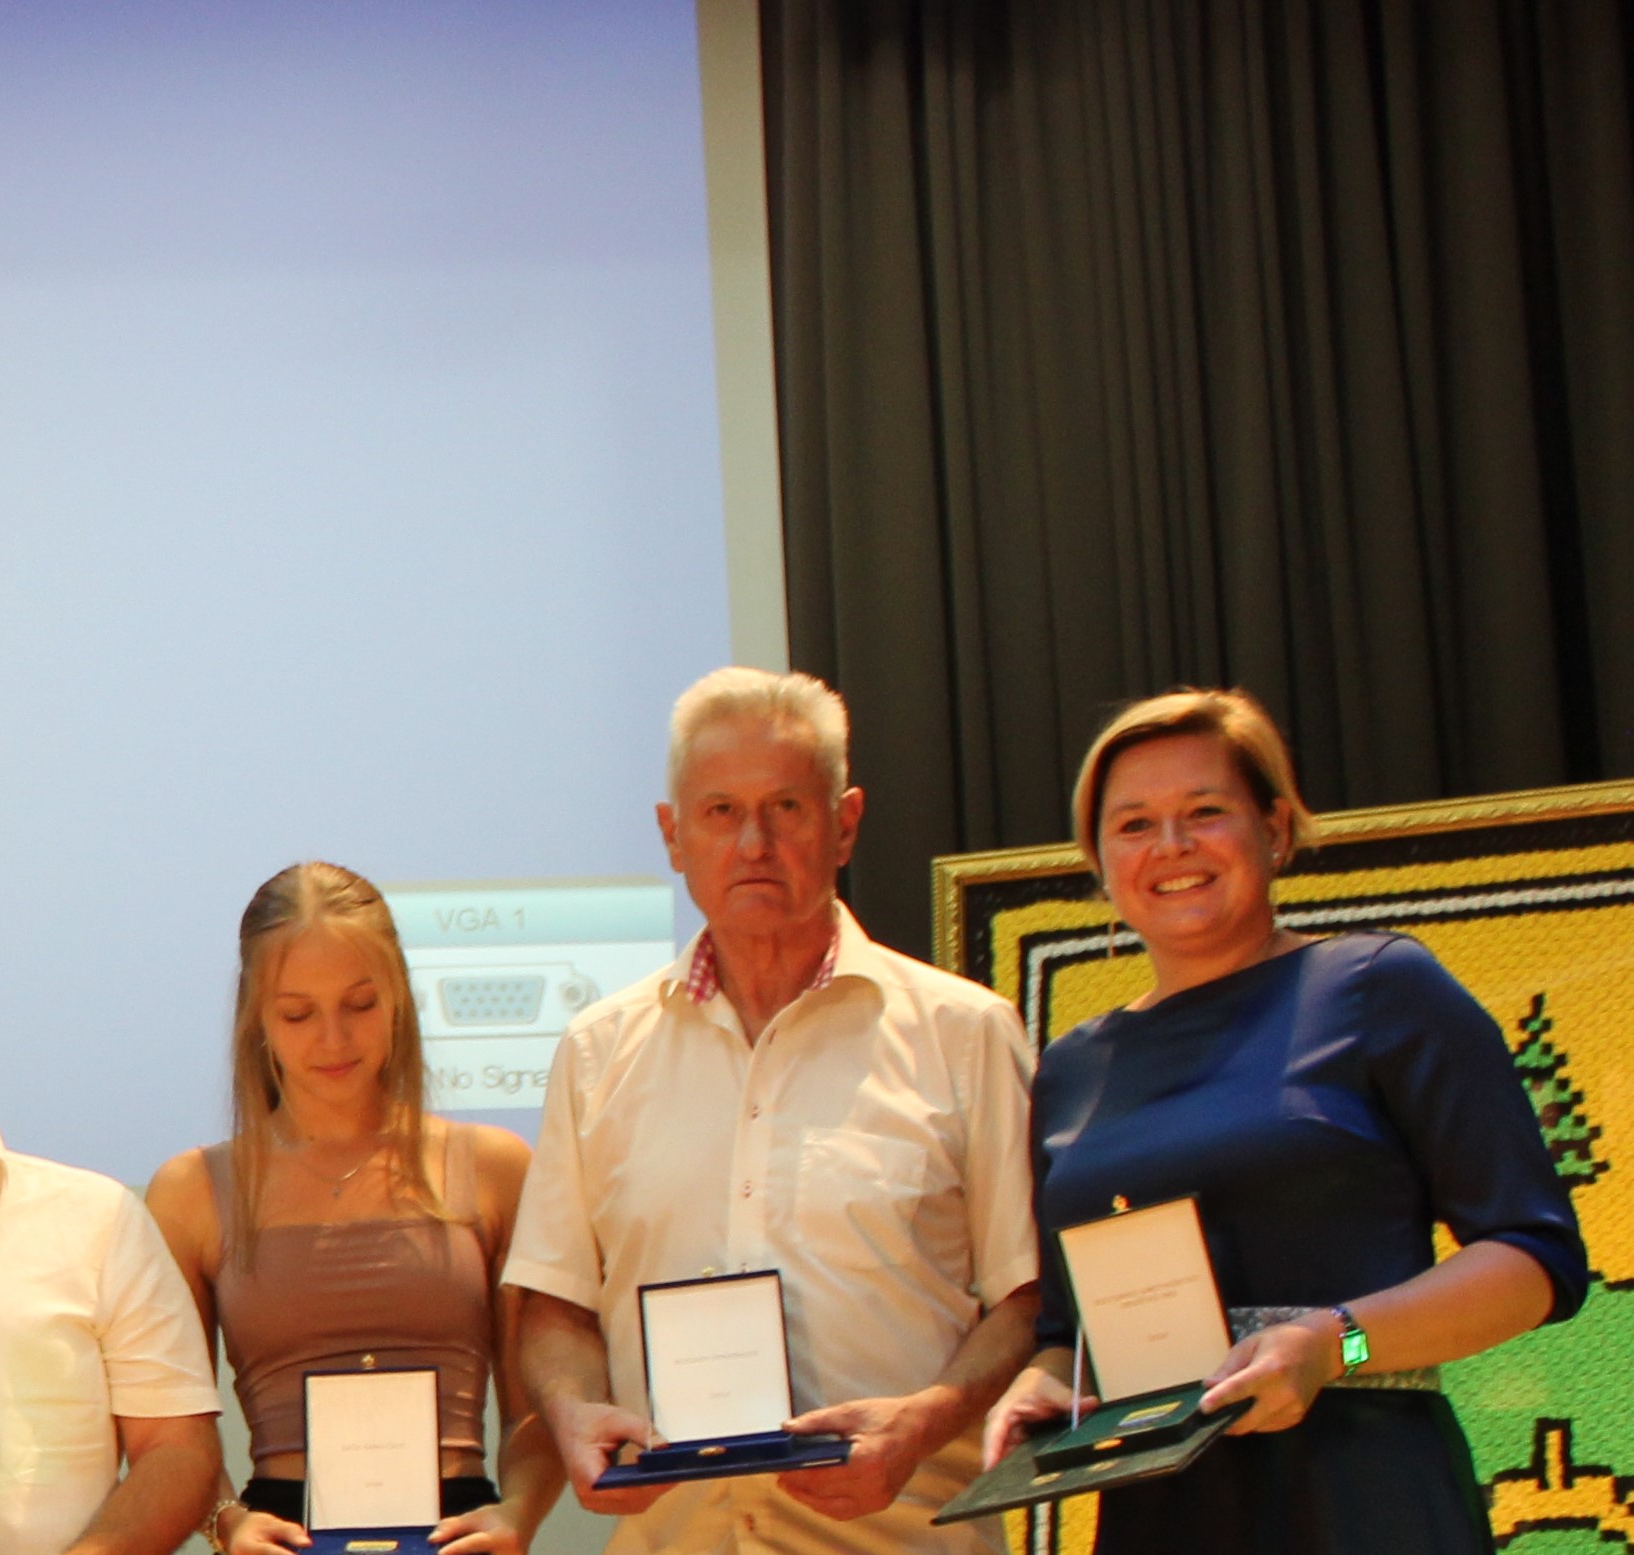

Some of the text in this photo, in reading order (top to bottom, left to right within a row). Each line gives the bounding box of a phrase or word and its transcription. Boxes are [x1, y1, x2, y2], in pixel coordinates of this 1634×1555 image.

[434, 907, 526, 932] VGA 1
[482, 1064, 548, 1095] Signa
